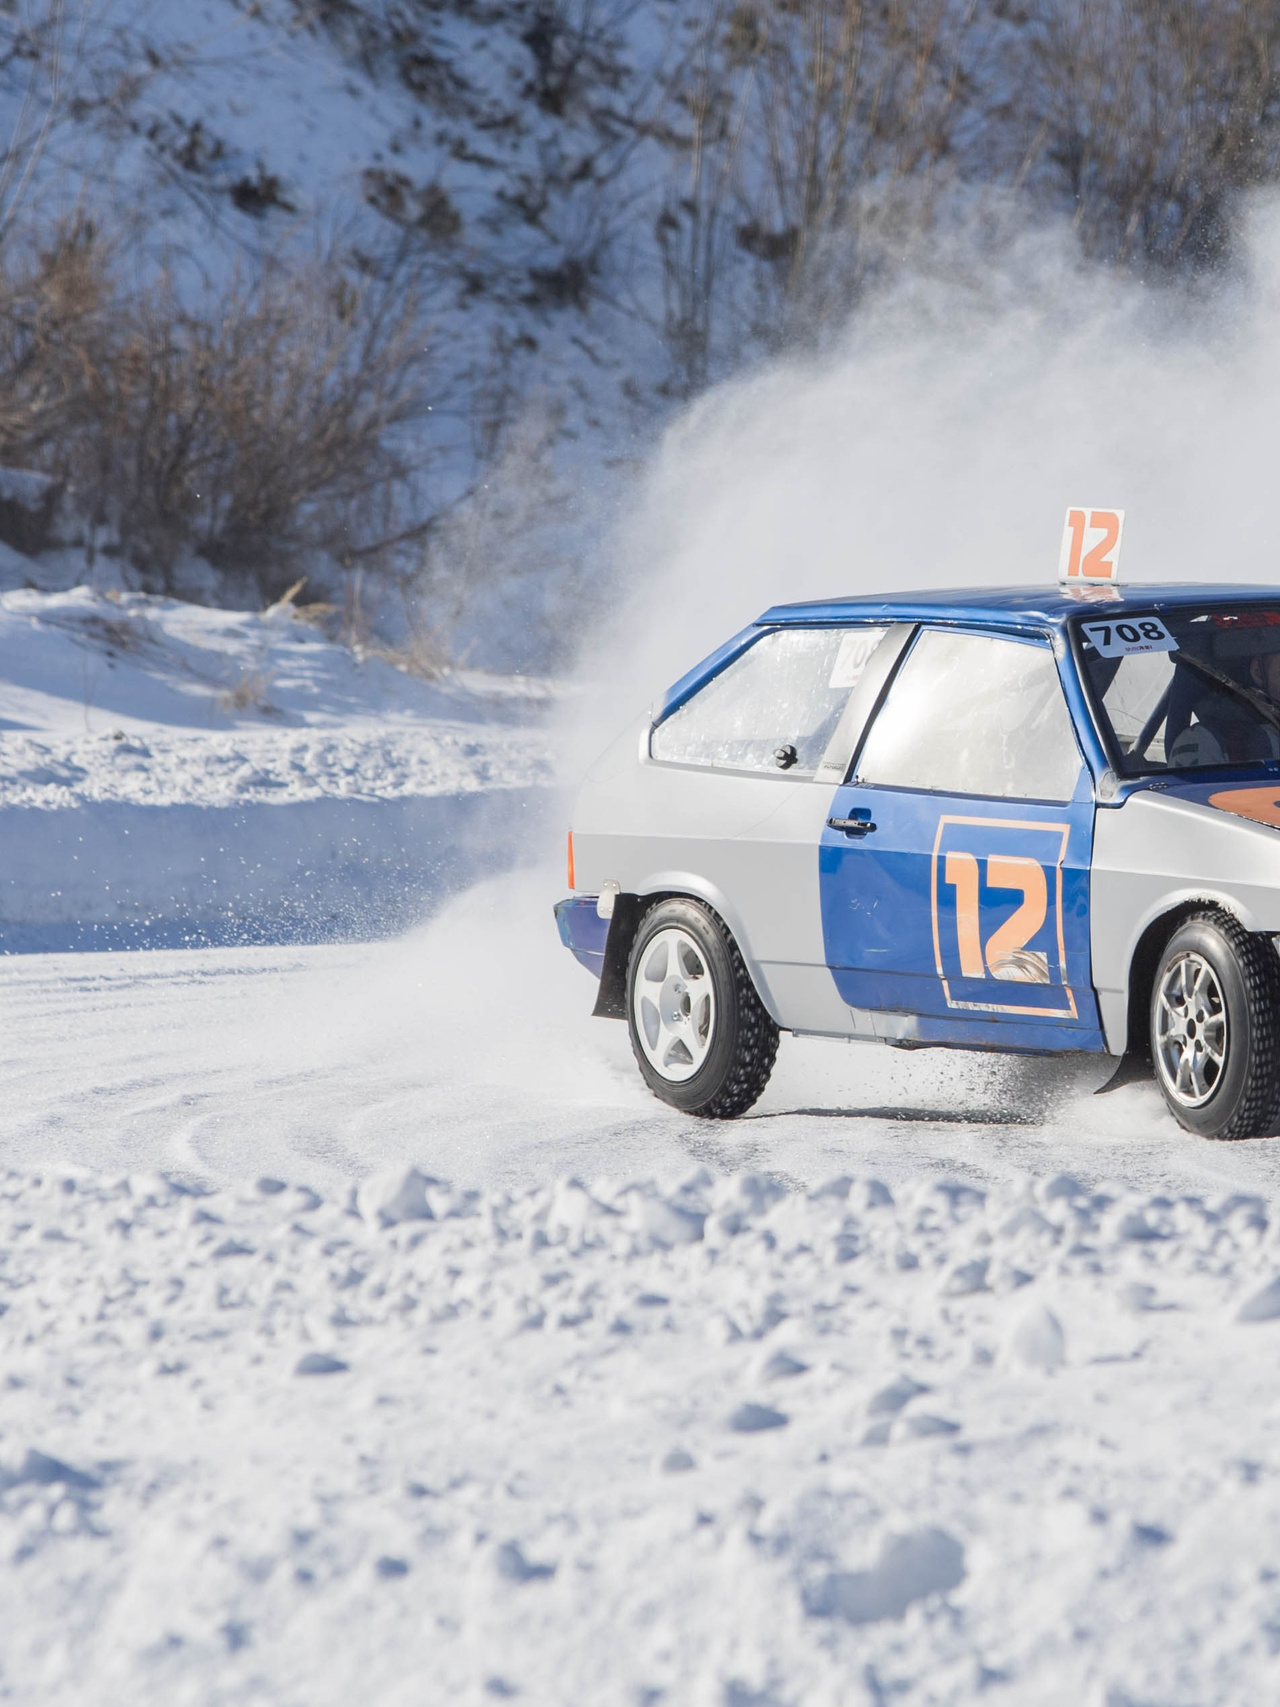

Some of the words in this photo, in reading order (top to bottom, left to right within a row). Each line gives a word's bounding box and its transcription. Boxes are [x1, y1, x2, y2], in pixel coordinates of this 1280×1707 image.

[1067, 510, 1119, 578] 12
[1089, 622, 1165, 646] 708
[945, 851, 1050, 984] 12
